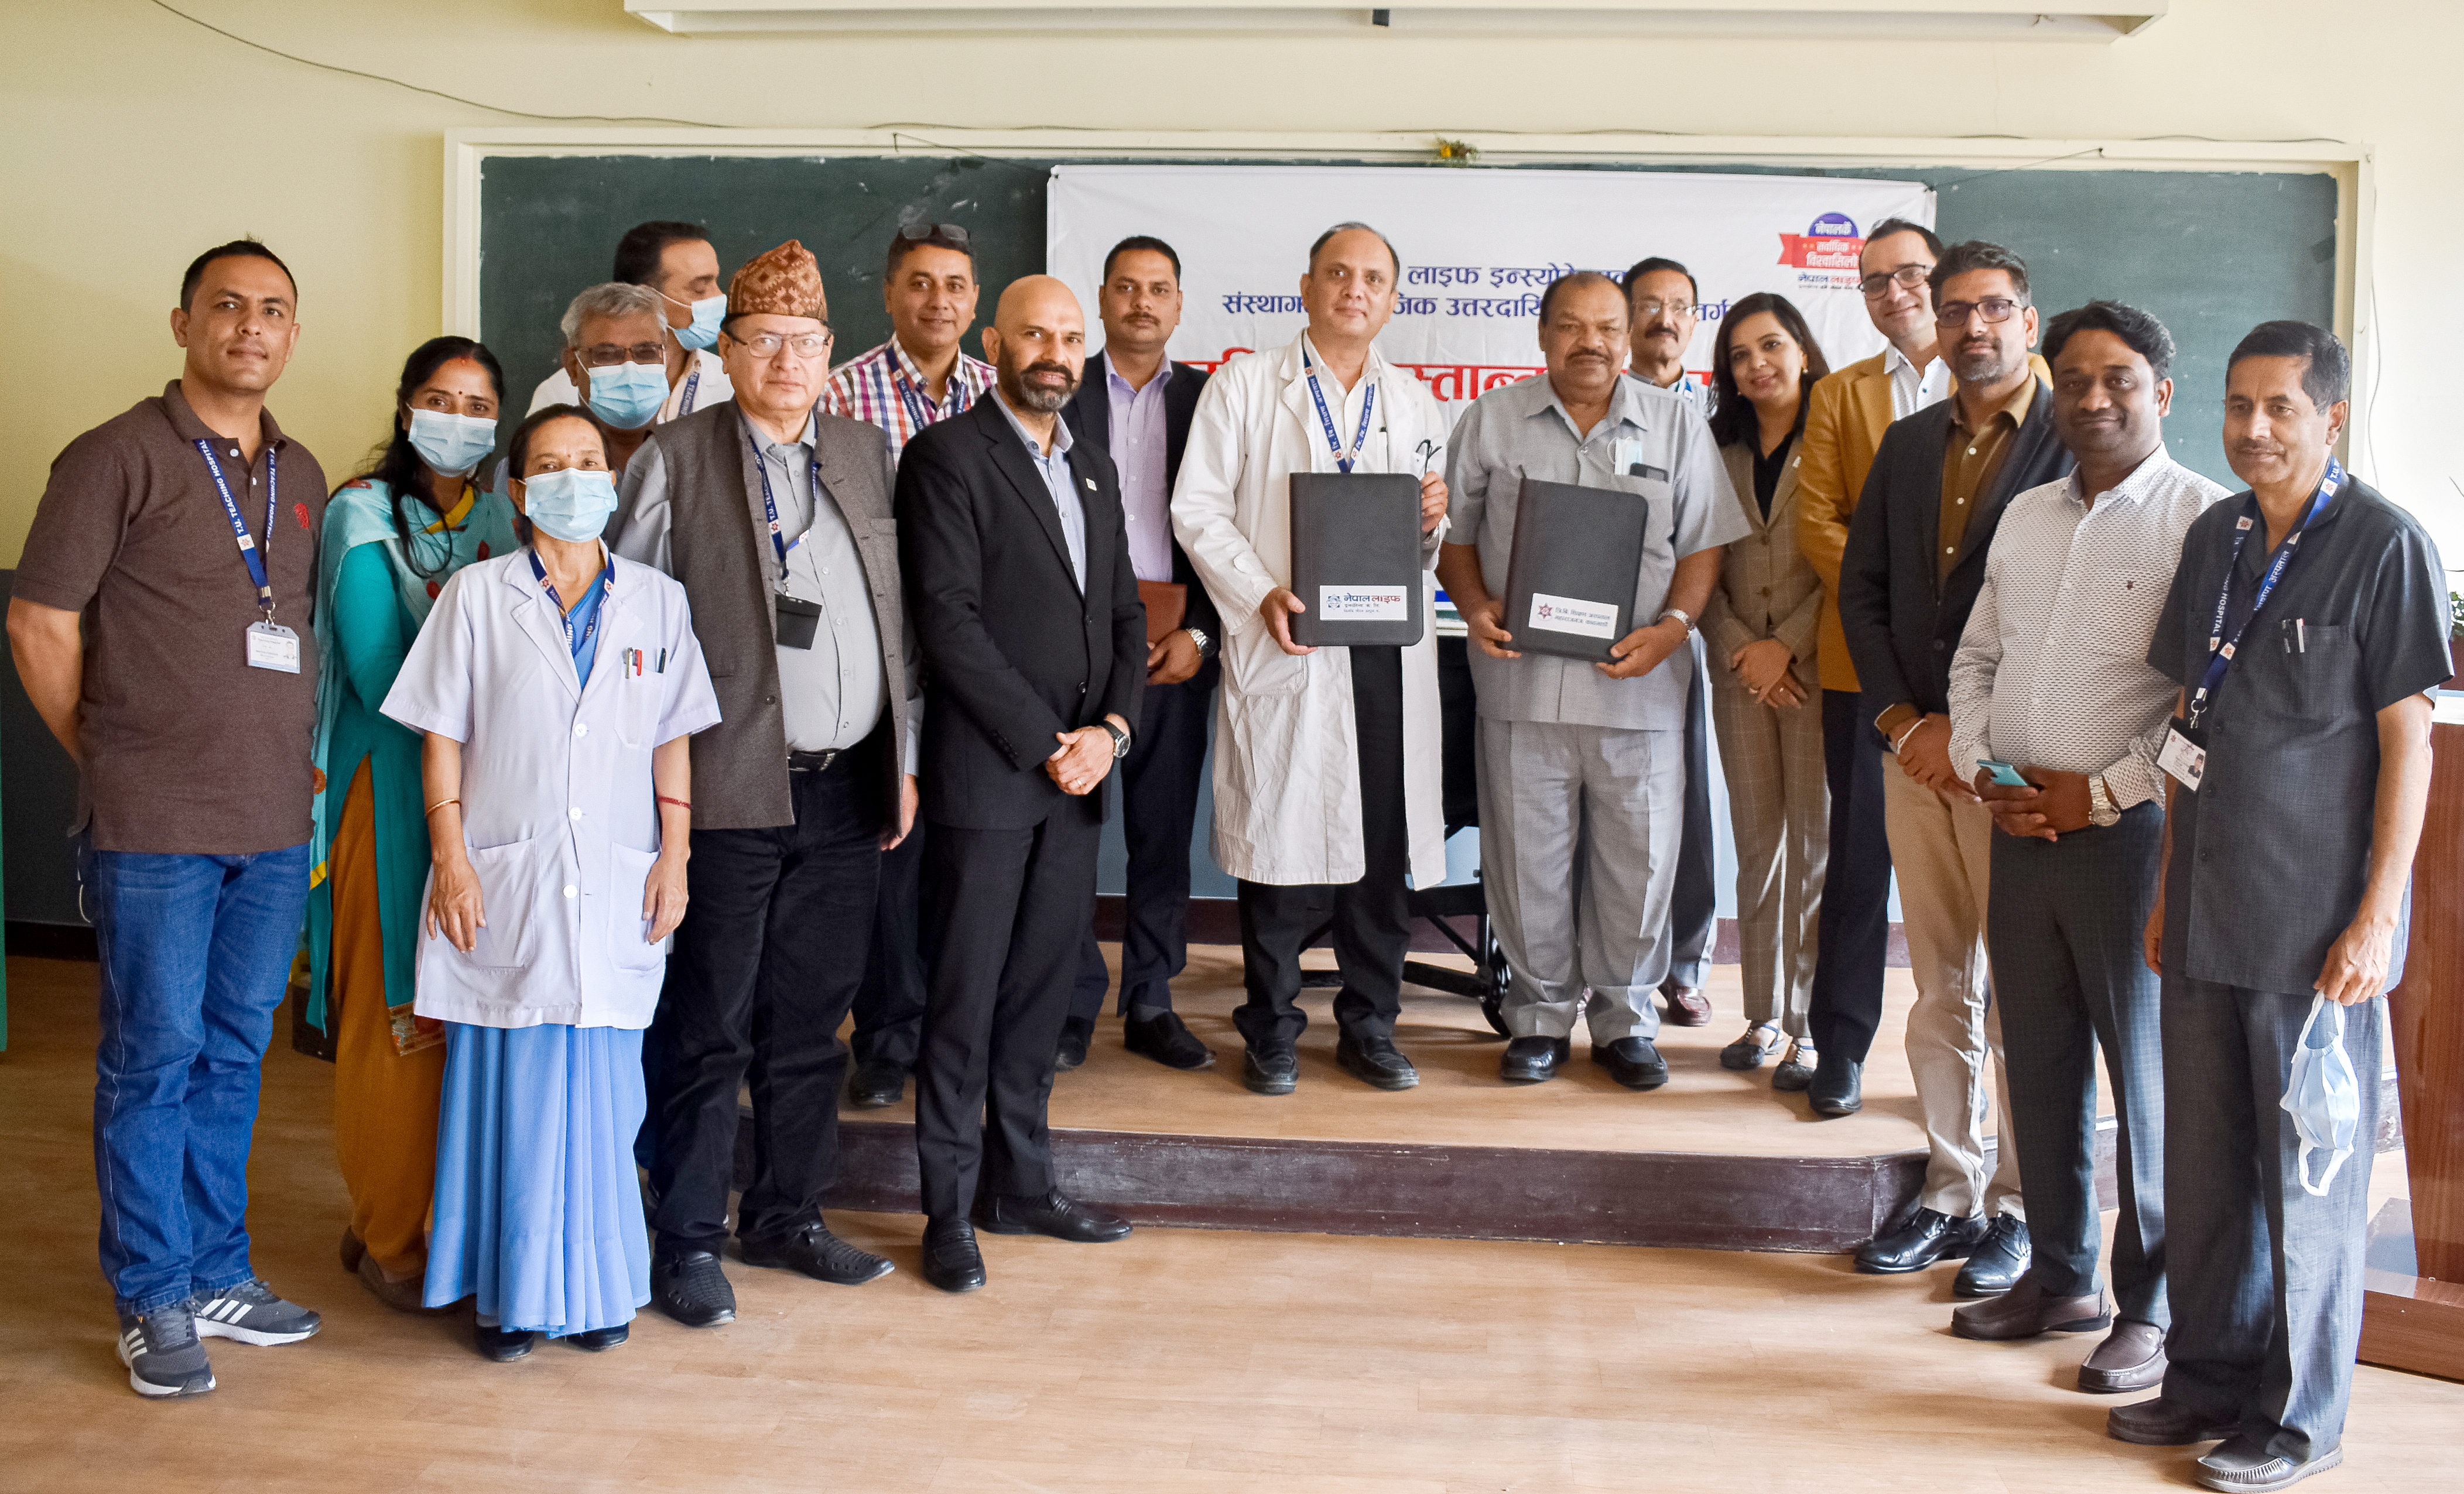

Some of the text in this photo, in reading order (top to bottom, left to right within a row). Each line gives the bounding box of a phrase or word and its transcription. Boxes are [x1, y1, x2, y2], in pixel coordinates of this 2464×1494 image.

[1816, 239, 1849, 252] सर्वाधिक
[1408, 266, 1481, 287] लाइफ
[1798, 272, 1828, 282] नेपाल
[1222, 291, 1308, 314] संस्थाग
[904, 390, 920, 420] TEACHING
[199, 439, 244, 534] T.U. TEACHING HOSPITAL
[768, 506, 776, 520] T.U.
[2268, 550, 2290, 583] अस्पताल
[1343, 592, 1401, 604] नेपाल लाइफ
[2212, 592, 2229, 634] HOSPITAL
